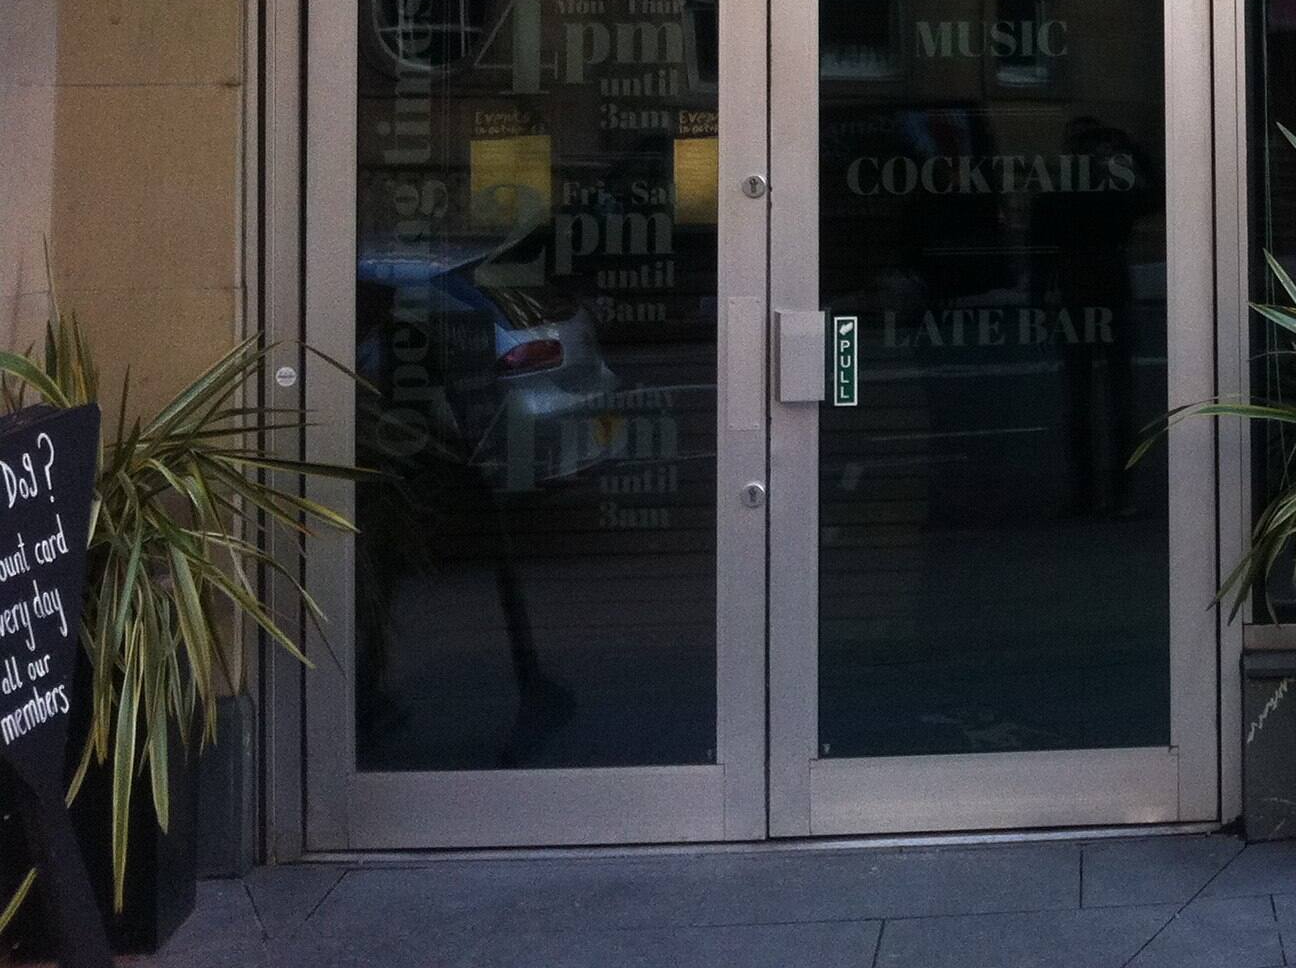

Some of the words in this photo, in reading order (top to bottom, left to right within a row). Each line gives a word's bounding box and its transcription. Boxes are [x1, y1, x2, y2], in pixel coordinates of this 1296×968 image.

[916, 20, 1067, 58] MUSIC
[600, 67, 679, 97] until
[600, 103, 671, 130] 3am
[846, 154, 1137, 195] COCKTAILS
[598, 260, 675, 288] until
[597, 297, 667, 323] 3am
[884, 308, 1005, 348] LATE
[1017, 306, 1114, 345] BAR
[840, 340, 850, 400] PULL
[599, 463, 678, 494] until
[34, 513, 69, 565] card
[33, 579, 68, 637] day
[2, 655, 23, 695] all
[27, 653, 51, 681] our
[1, 684, 70, 745] members
